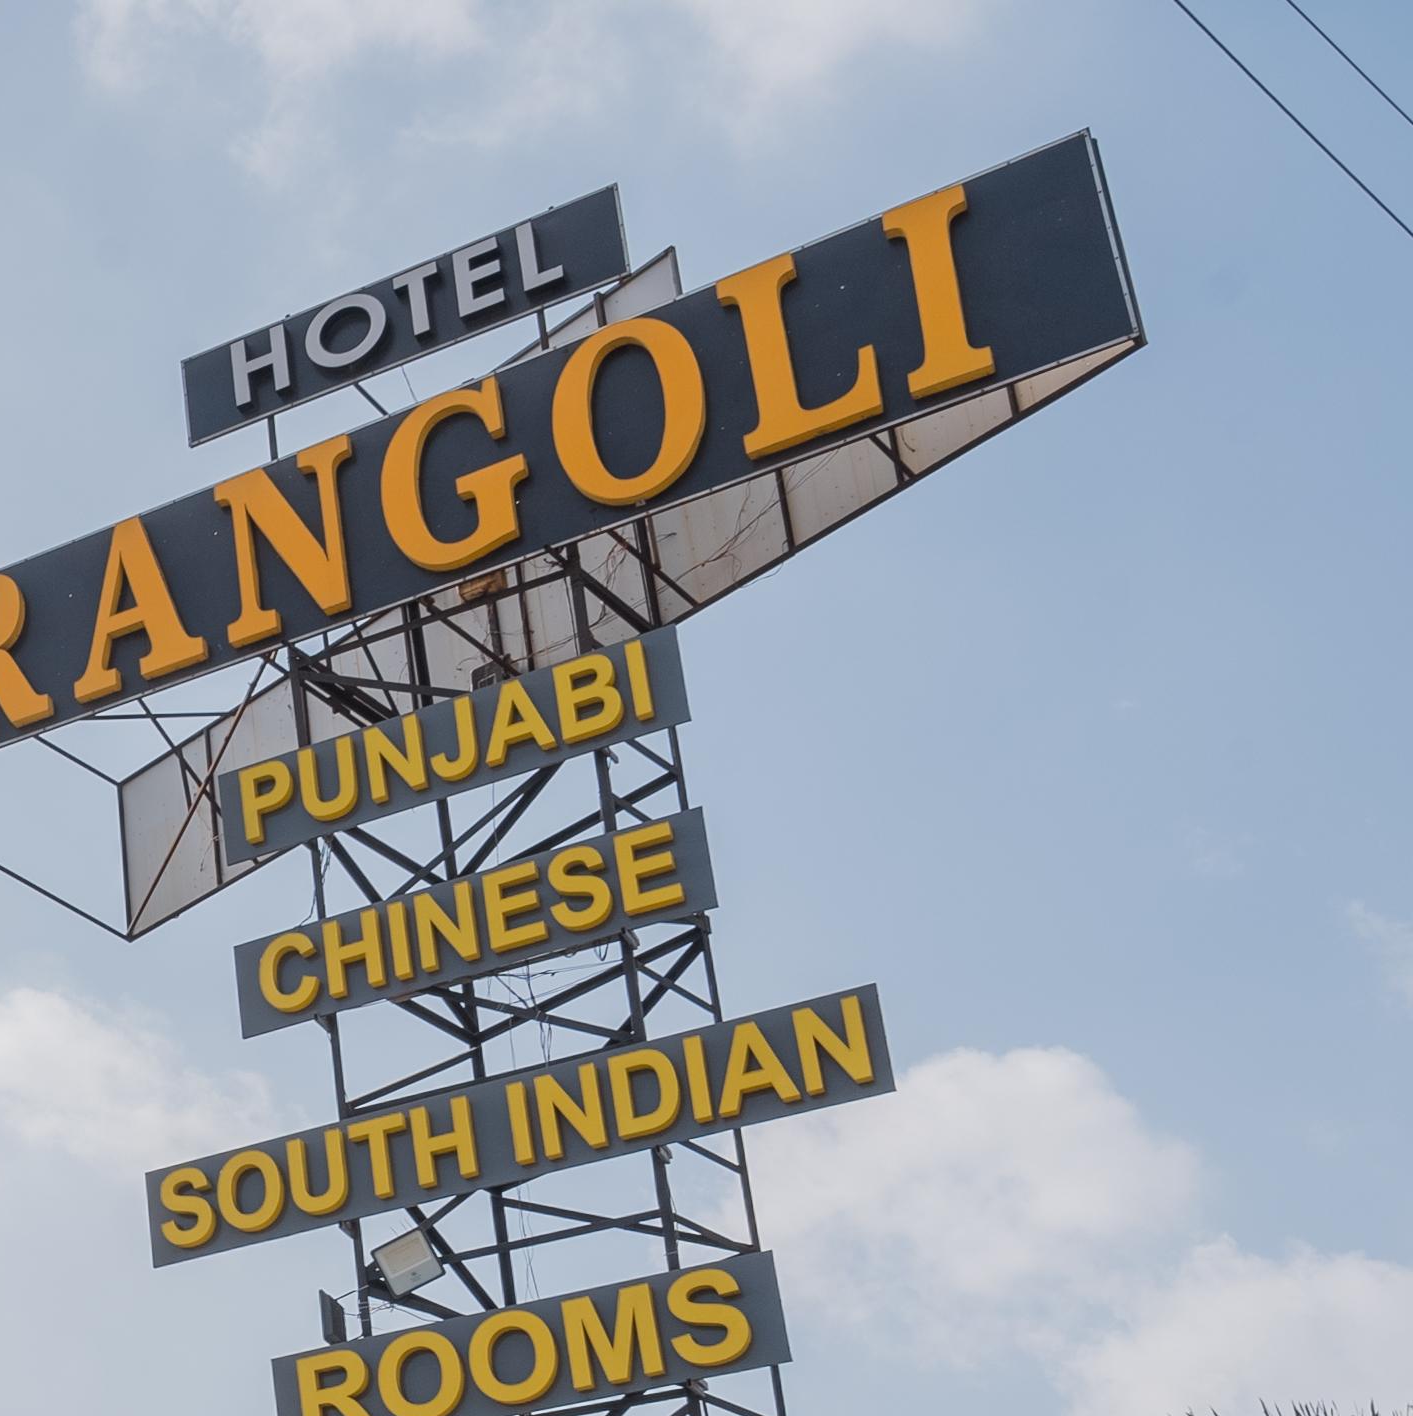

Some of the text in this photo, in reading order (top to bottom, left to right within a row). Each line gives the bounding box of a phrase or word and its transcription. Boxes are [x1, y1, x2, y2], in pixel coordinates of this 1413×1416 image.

[229, 221, 566, 410] HOTEL
[237, 639, 655, 846] PUNJABI
[258, 821, 686, 1014] CHINESE
[159, 994, 875, 1249] SOUTH INDIAN
